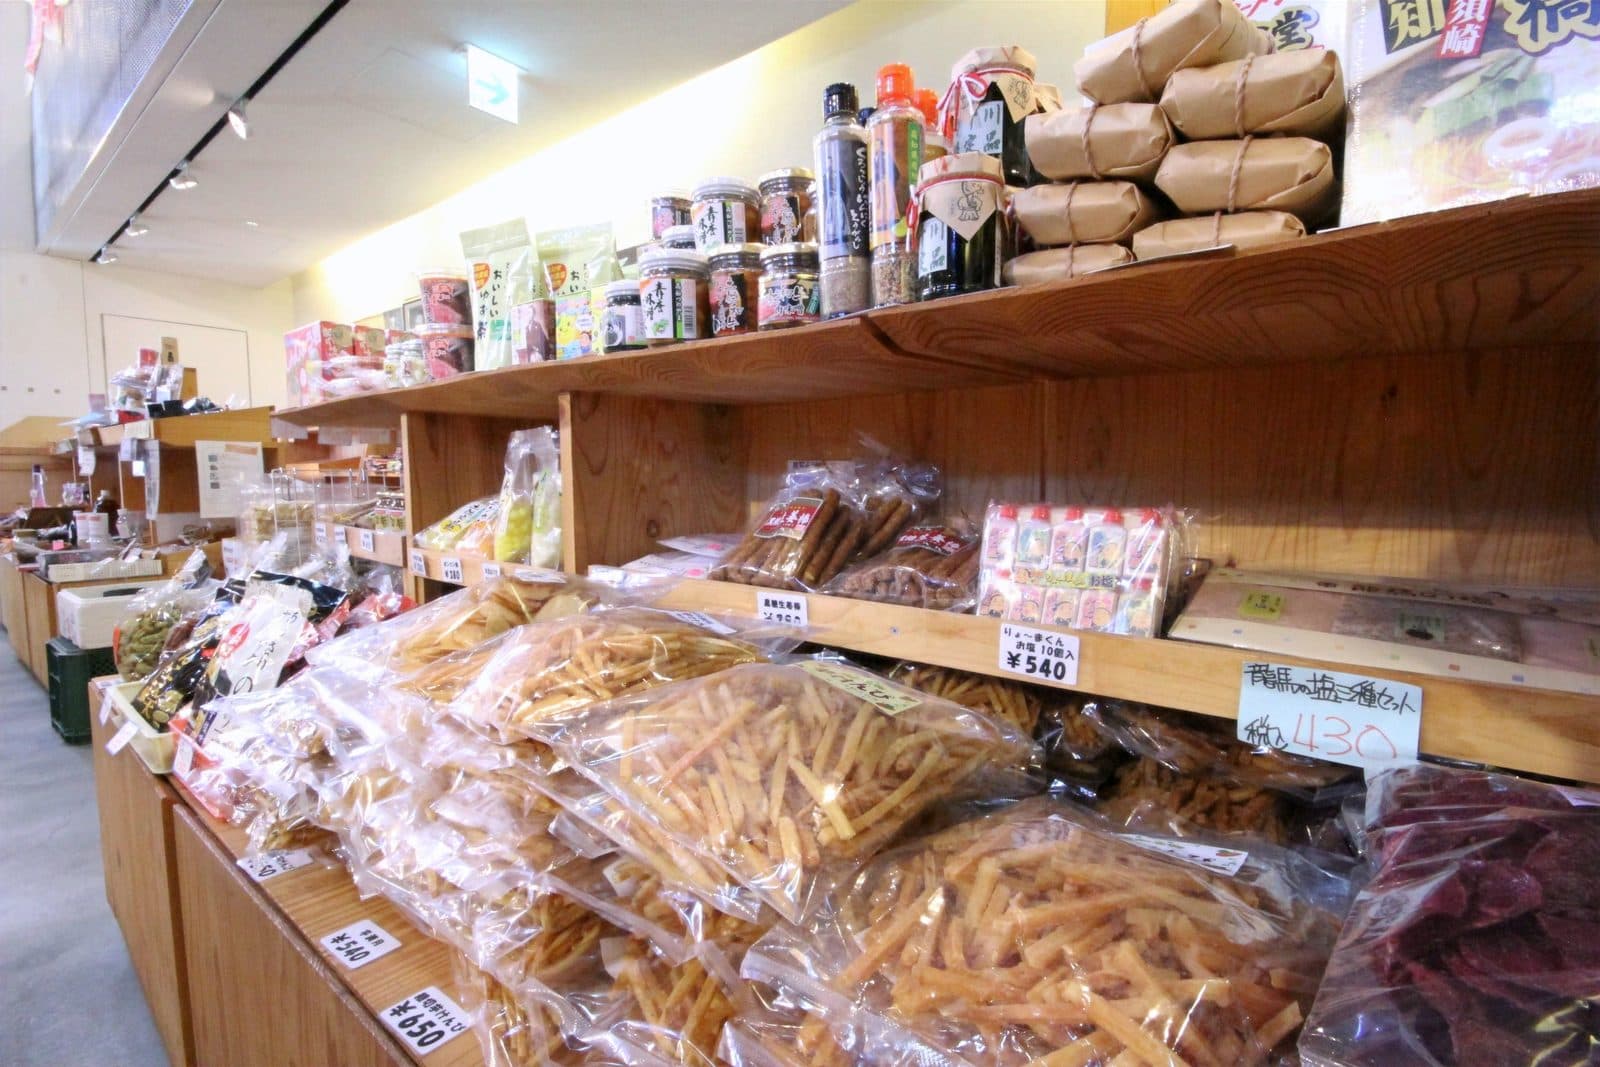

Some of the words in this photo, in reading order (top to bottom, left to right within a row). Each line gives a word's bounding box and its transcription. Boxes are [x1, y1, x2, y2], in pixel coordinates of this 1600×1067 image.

[1440, 0, 1487, 55] 須崎
[1006, 651, 1067, 681] ¥540
[1015, 640, 1036, 654] お塩
[1040, 645, 1075, 661] 10個入
[1292, 713, 1398, 760] 430
[330, 932, 371, 962] ¥540
[389, 1000, 445, 1048] ¥650
